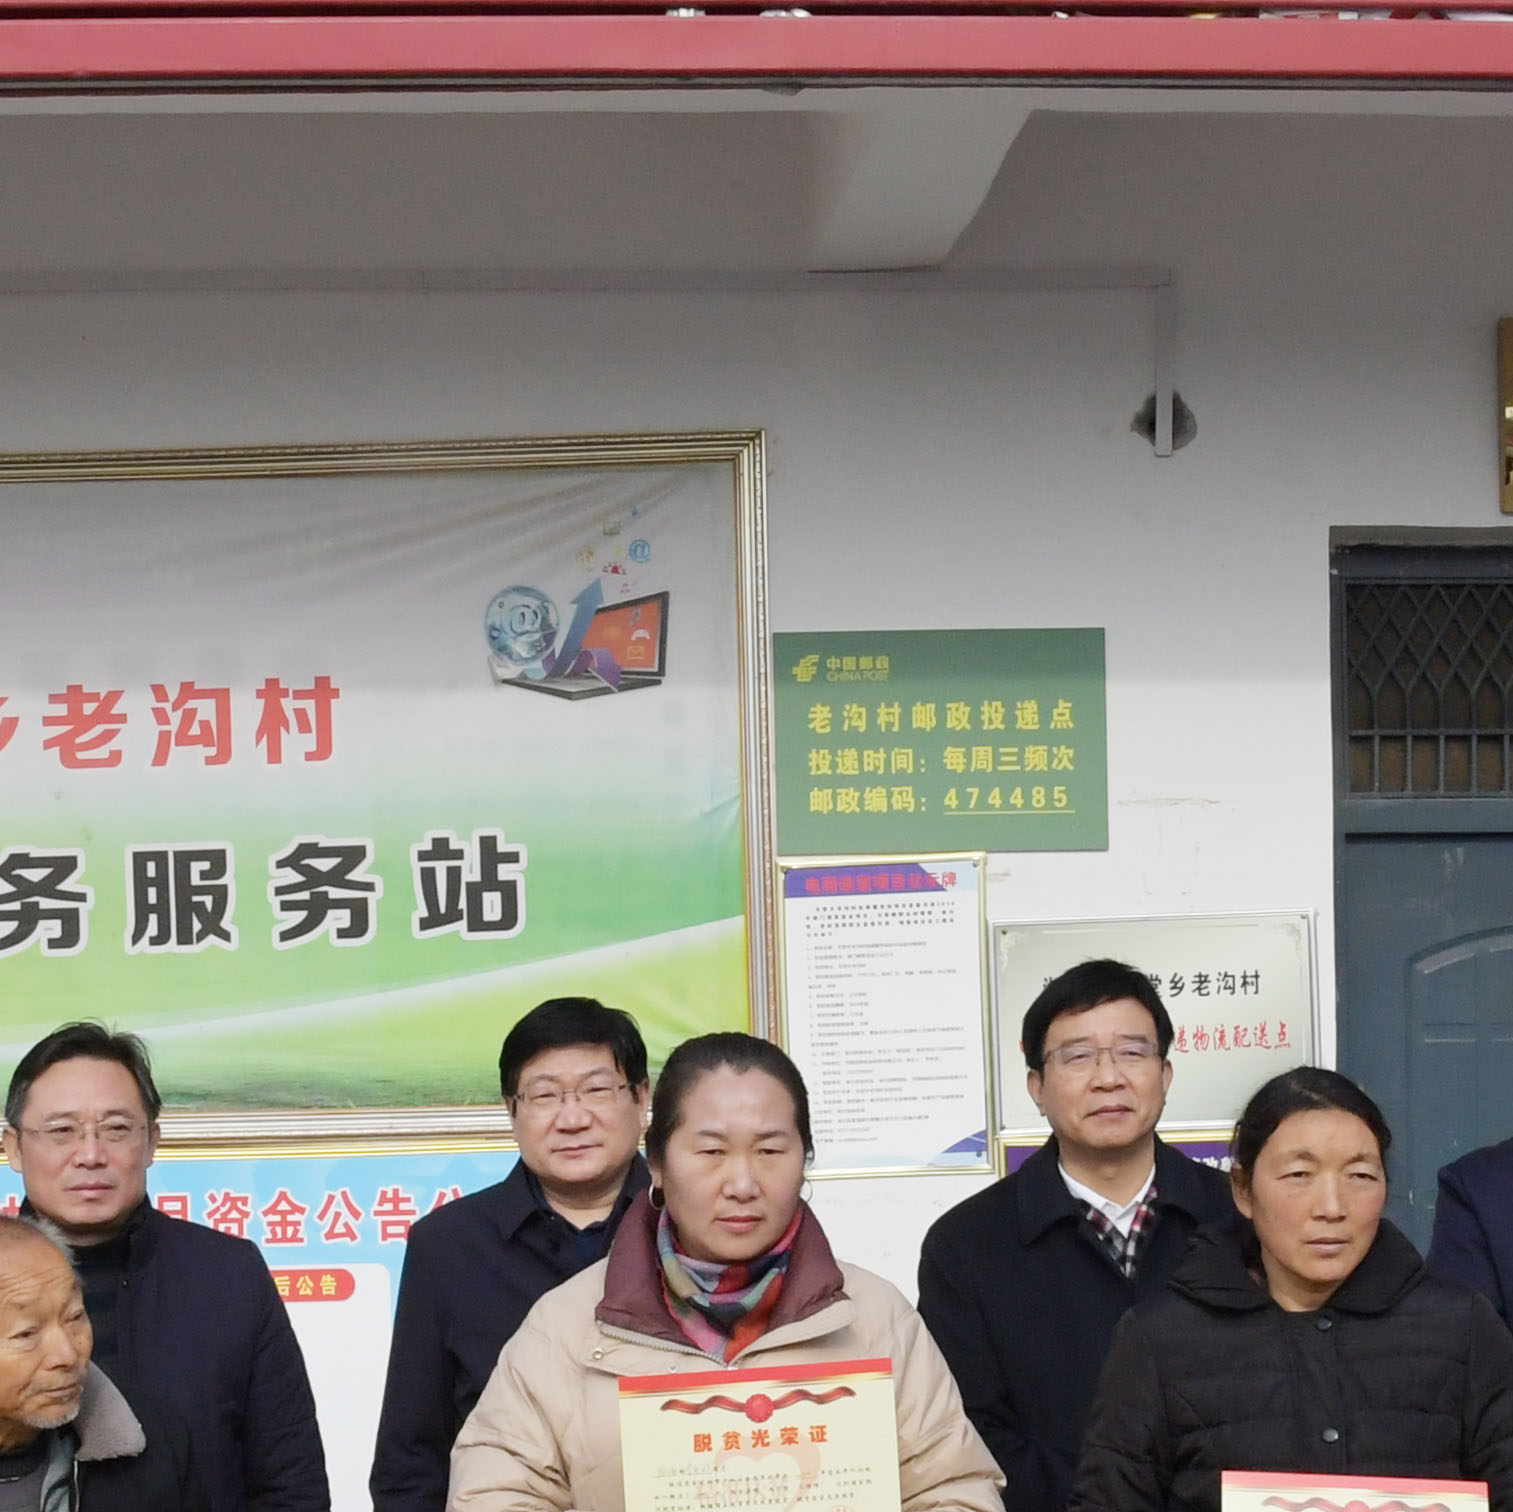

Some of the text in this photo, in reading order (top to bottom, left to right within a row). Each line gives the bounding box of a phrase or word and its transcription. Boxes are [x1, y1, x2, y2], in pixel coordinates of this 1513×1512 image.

[807, 699, 1075, 734] 老沟村邮政投递点
[693, 1424, 828, 1453] 脱贫光荣证
